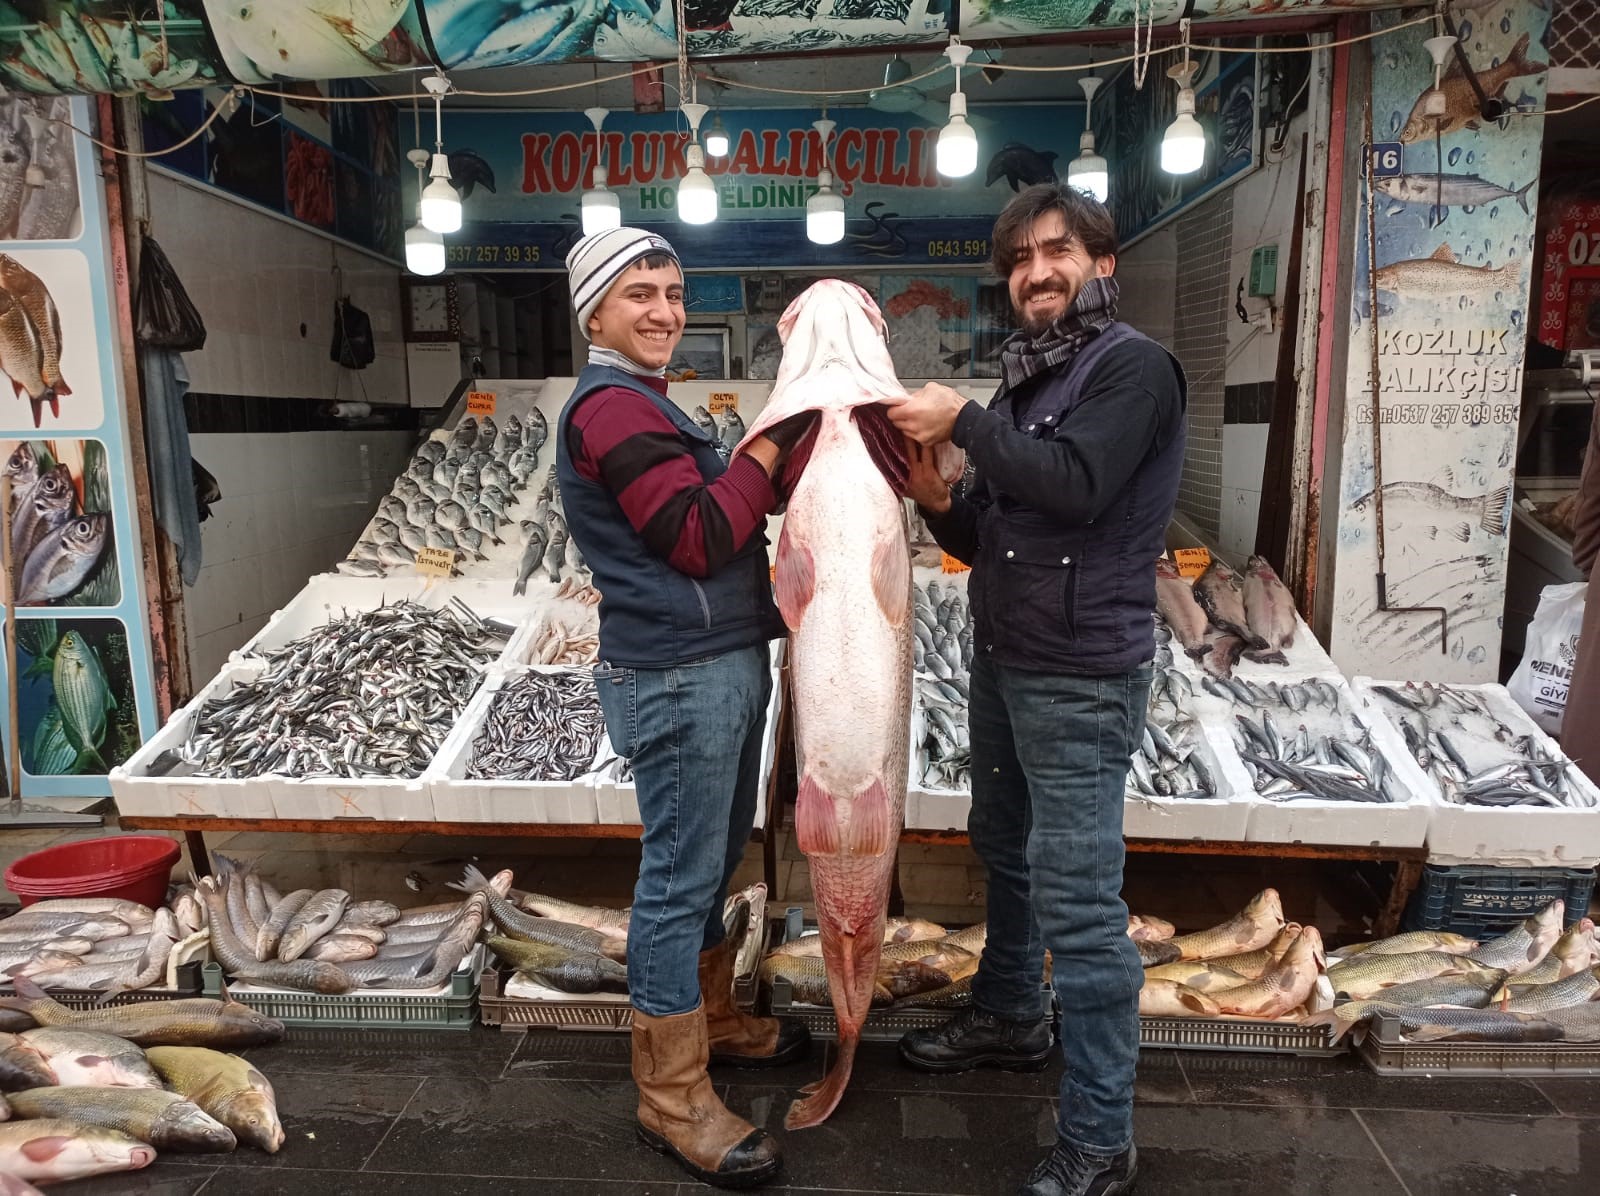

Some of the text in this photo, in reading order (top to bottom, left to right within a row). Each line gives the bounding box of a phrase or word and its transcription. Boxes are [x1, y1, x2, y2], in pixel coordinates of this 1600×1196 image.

[521, 131, 691, 194] KOZLUK
[1371, 150, 1398, 169] 16
[640, 179, 820, 209] HO ELDİNİZ
[447, 246, 540, 262] 537 257 39 35
[928, 240, 987, 256] 0543 591
[1379, 330, 1511, 356] KOZLUK
[713, 393, 734, 401] OLTA
[1431, 404, 1460, 424] 257
[1462, 404, 1491, 424] 389
[1494, 404, 1513, 424] 35
[425, 548, 449, 557] TAZE
